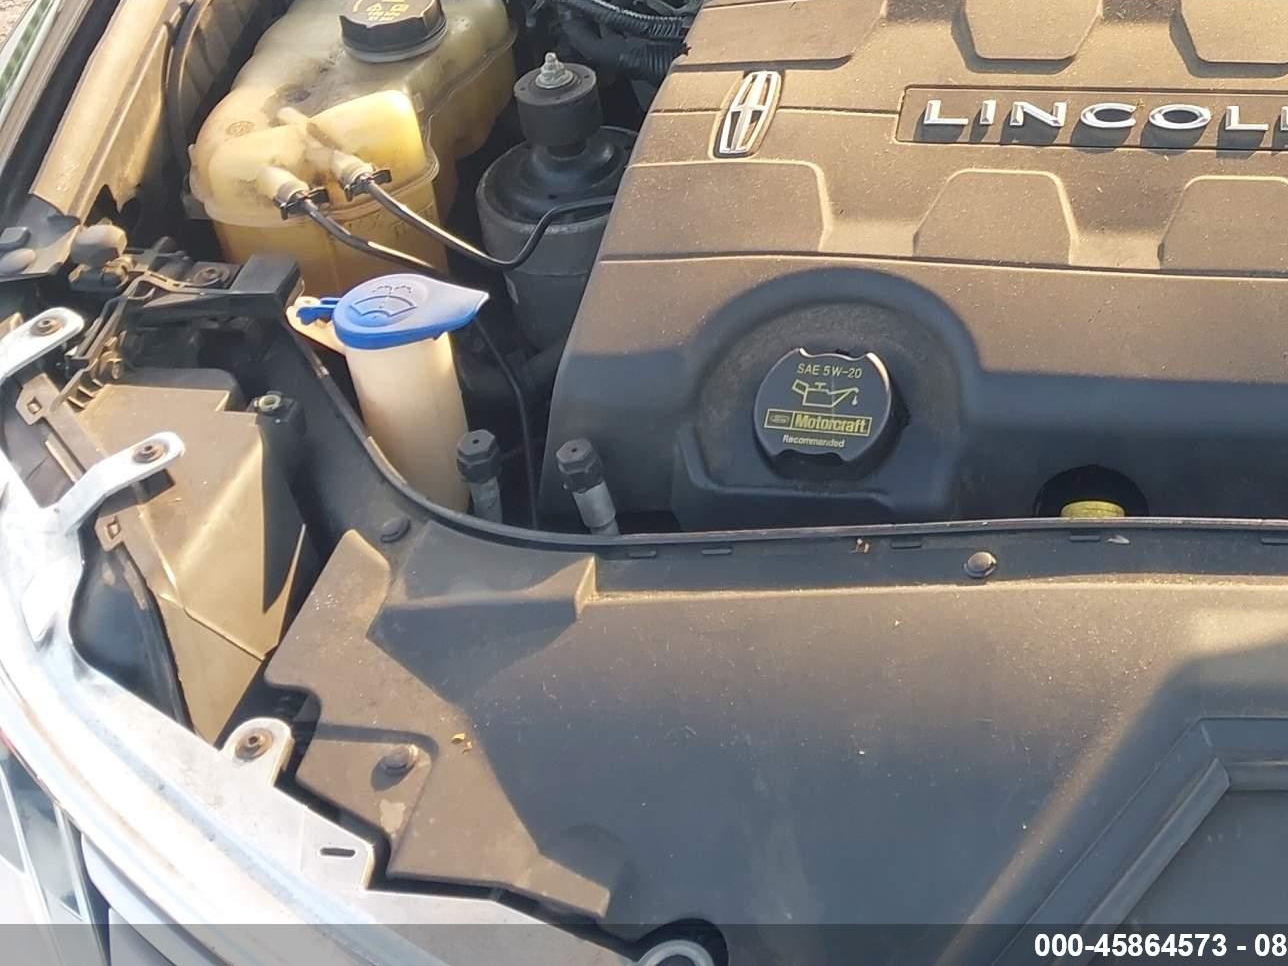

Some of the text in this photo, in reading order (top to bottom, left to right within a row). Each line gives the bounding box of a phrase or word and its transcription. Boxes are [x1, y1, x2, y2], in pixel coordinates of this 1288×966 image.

[796, 363, 863, 379] SAE 5W-20
[794, 414, 867, 433] Motorcraft
[782, 434, 845, 448] Recommended
